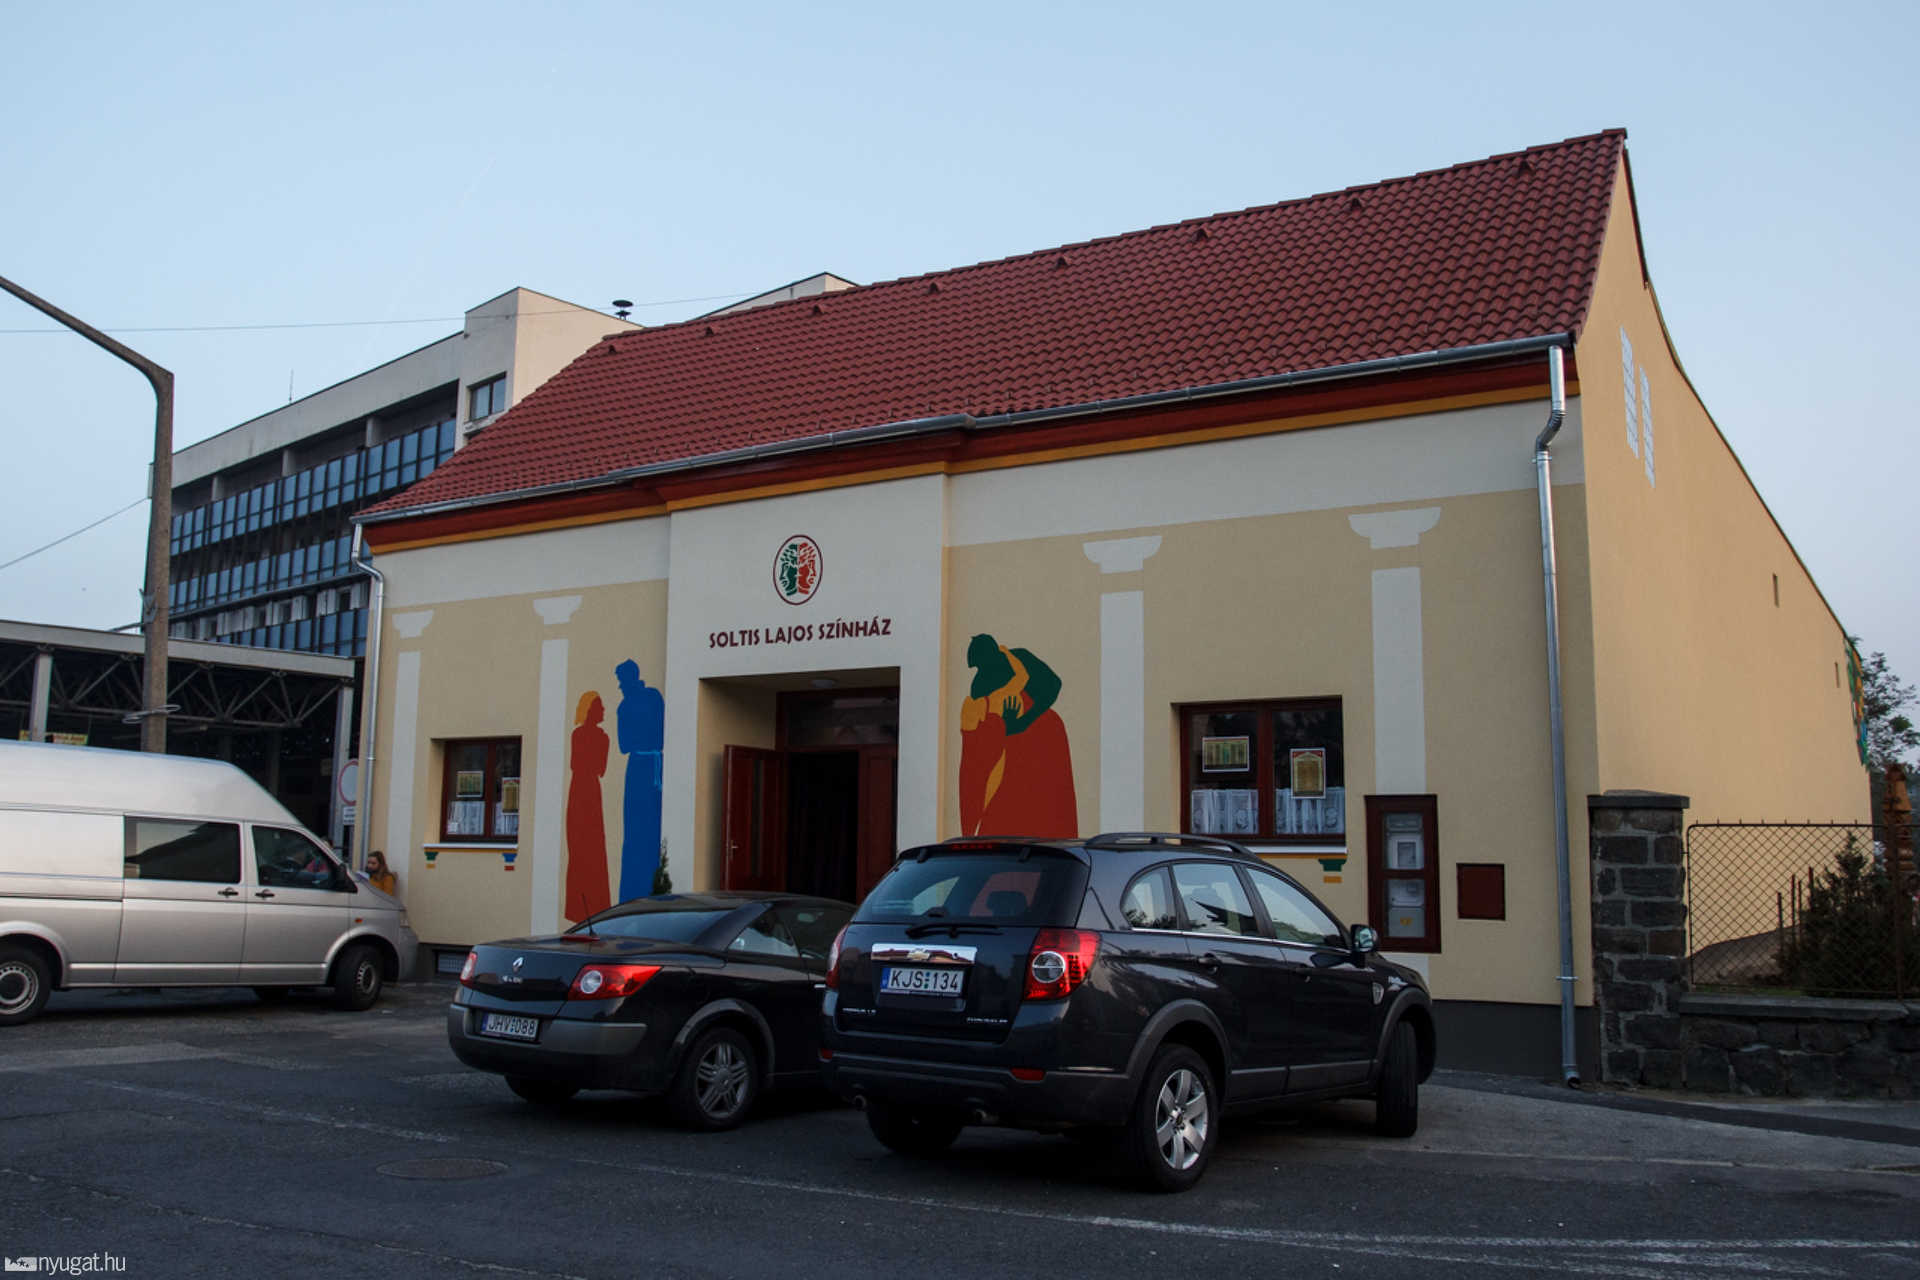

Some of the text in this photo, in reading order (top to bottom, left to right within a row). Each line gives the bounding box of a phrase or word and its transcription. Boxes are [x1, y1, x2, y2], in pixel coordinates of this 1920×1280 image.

[709, 616, 892, 648] SOLTIS LAJOS SZÍNHÁZ
